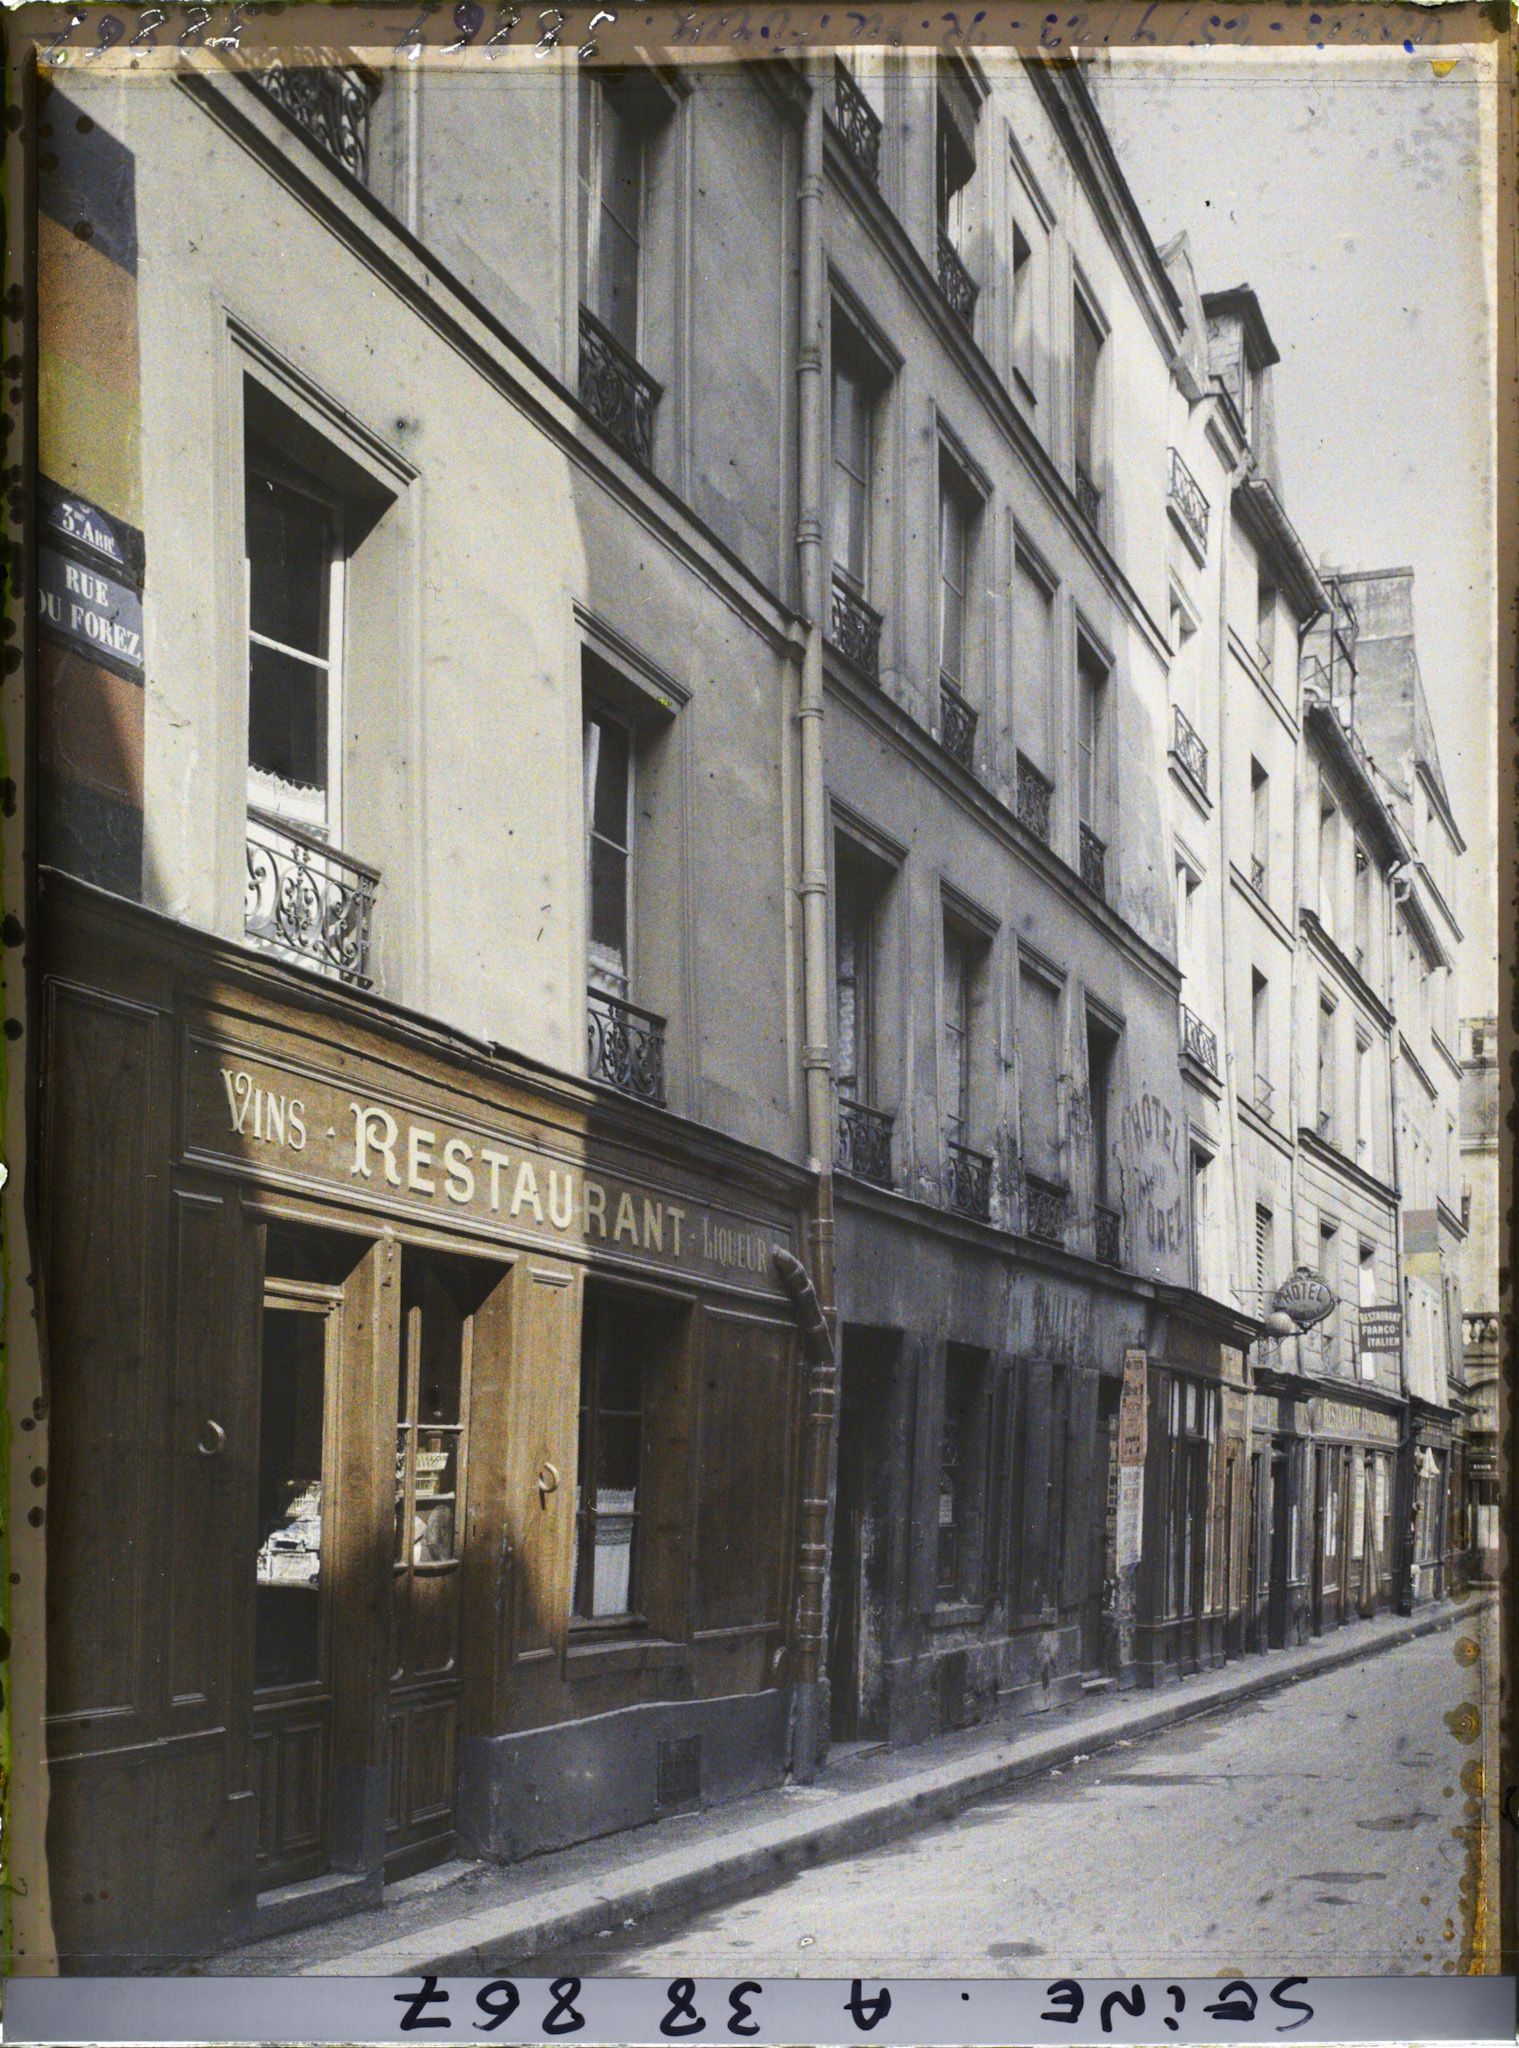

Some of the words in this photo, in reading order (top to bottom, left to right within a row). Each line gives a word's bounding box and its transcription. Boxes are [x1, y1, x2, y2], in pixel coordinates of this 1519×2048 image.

[64, 564, 109, 608] RUE
[70, 603, 142, 659] FOREZ
[220, 1068, 307, 1151] VINS
[350, 1102, 685, 1256] RESTAURANT
[1280, 1281, 1325, 1304] HOTEL
[1361, 1324, 1400, 1336] FRANCO-
[393, 1975, 587, 2034] 867
[659, 1977, 763, 2036] 38
[843, 1978, 891, 2031] A
